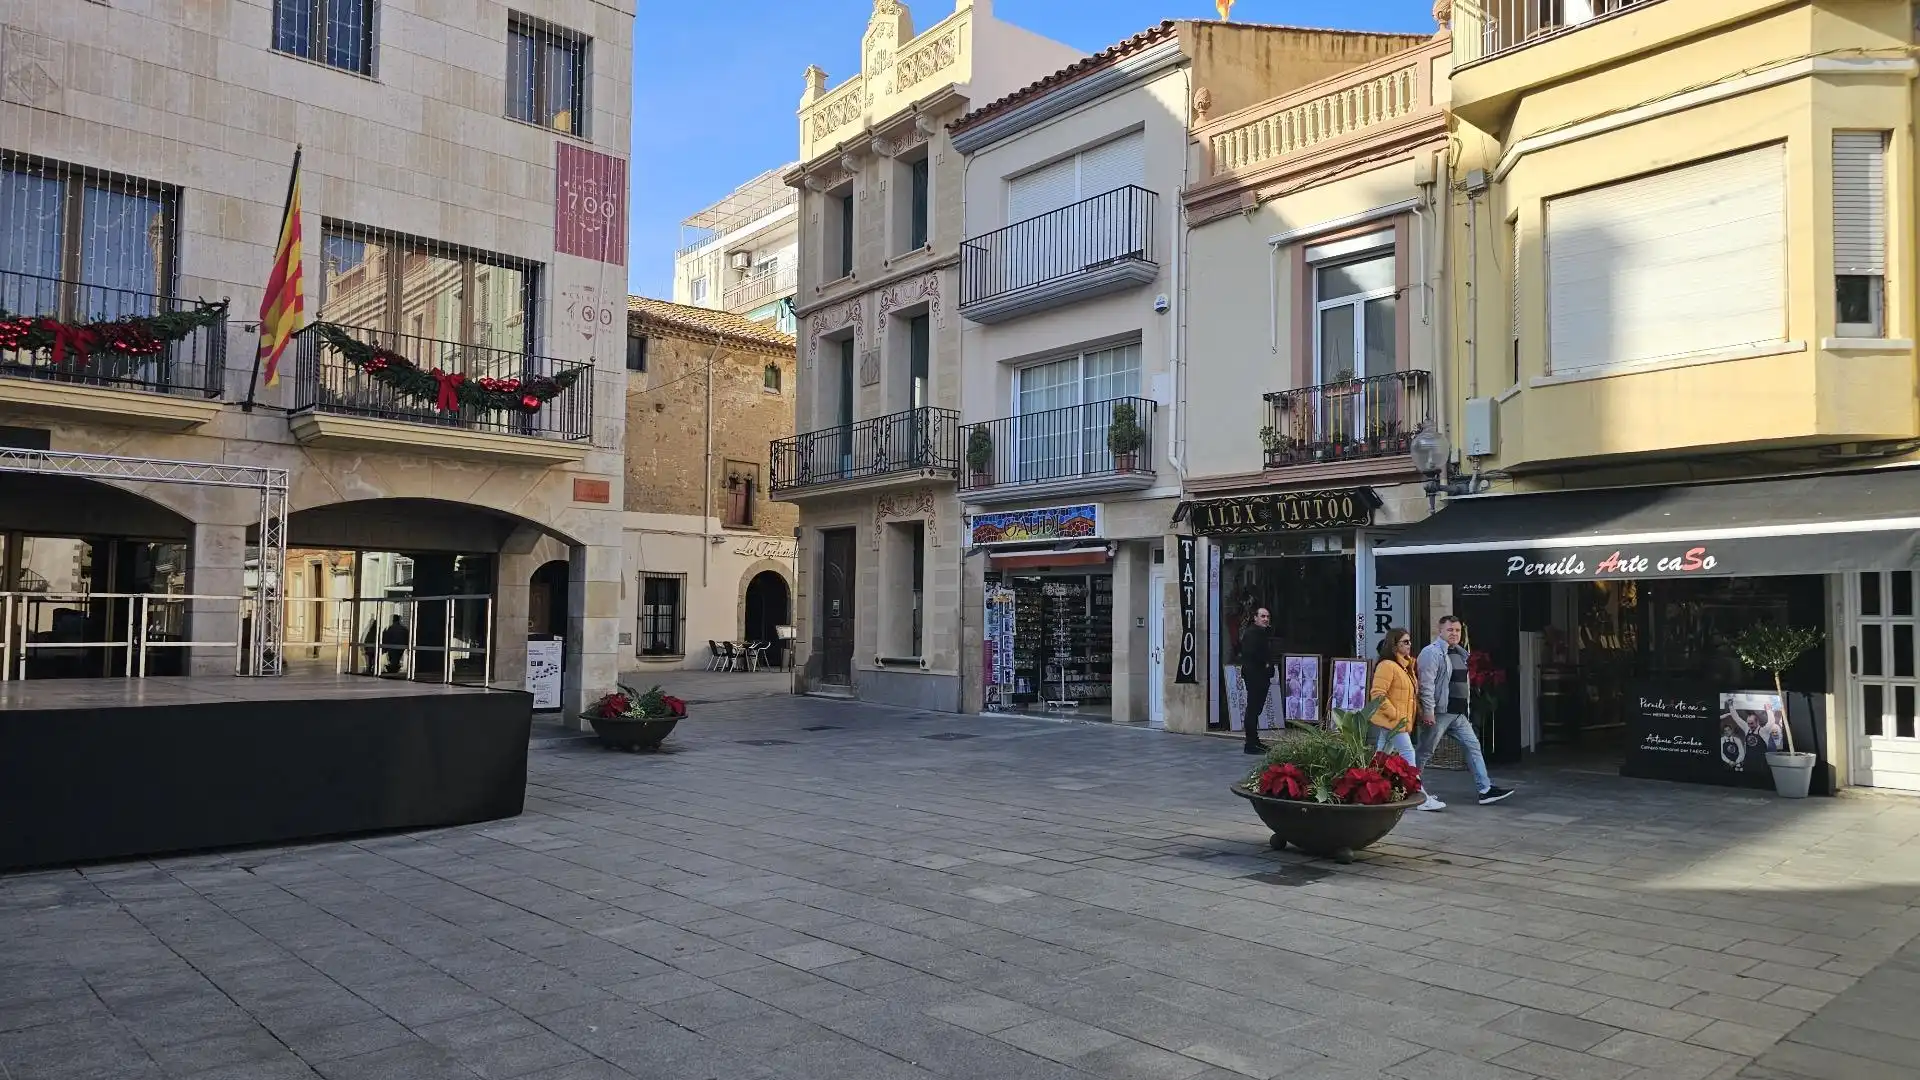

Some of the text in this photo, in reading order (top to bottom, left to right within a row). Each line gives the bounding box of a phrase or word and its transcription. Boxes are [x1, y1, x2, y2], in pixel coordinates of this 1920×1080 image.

[568, 191, 615, 218] 700
[1207, 497, 1354, 527] ALEX TATTOO
[1507, 547, 1718, 576] Pernils Arte caSo
[1181, 539, 1194, 676] TATTOO
[1640, 697, 1666, 710] Pernils
